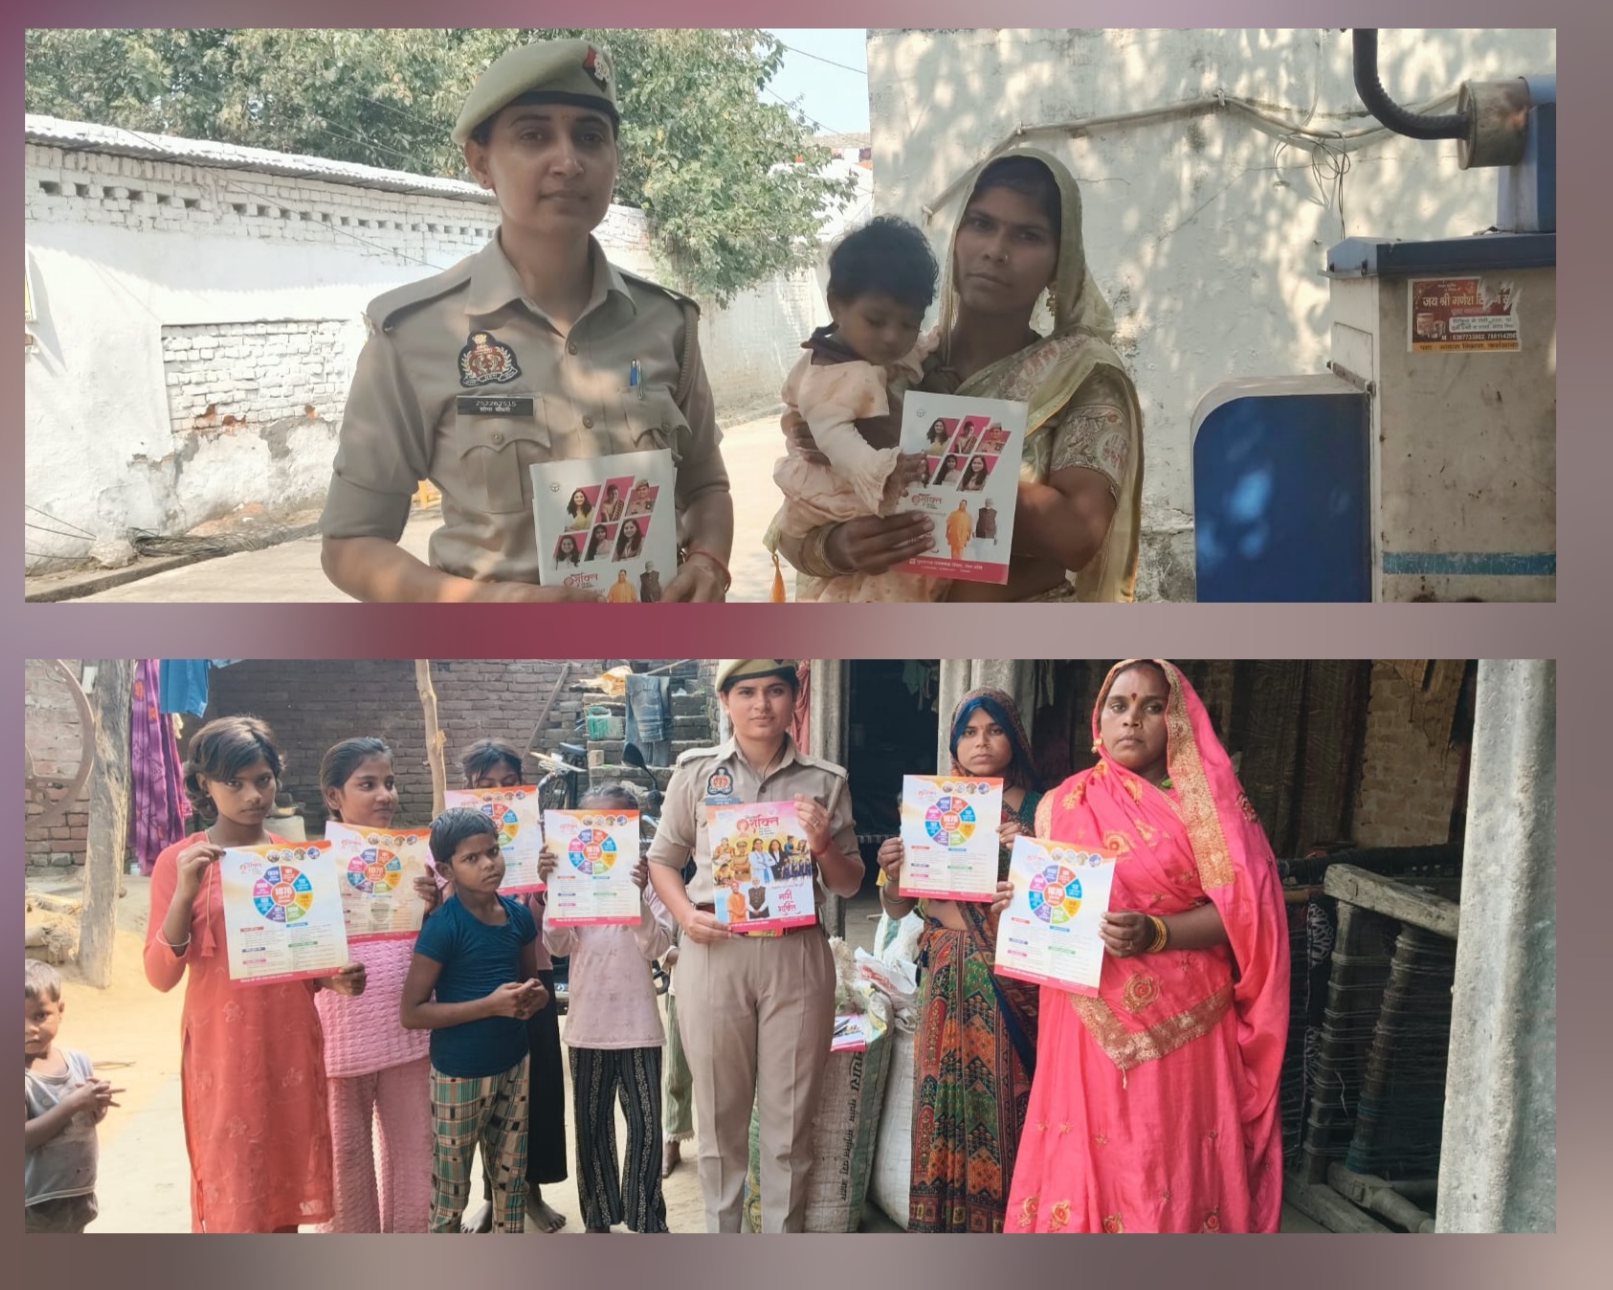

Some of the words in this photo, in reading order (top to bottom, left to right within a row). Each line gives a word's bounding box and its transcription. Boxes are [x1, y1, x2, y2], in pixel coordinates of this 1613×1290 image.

[1423, 296, 1438, 307] जय
[1440, 293, 1450, 307] श्री
[1452, 294, 1474, 306] गणेश
